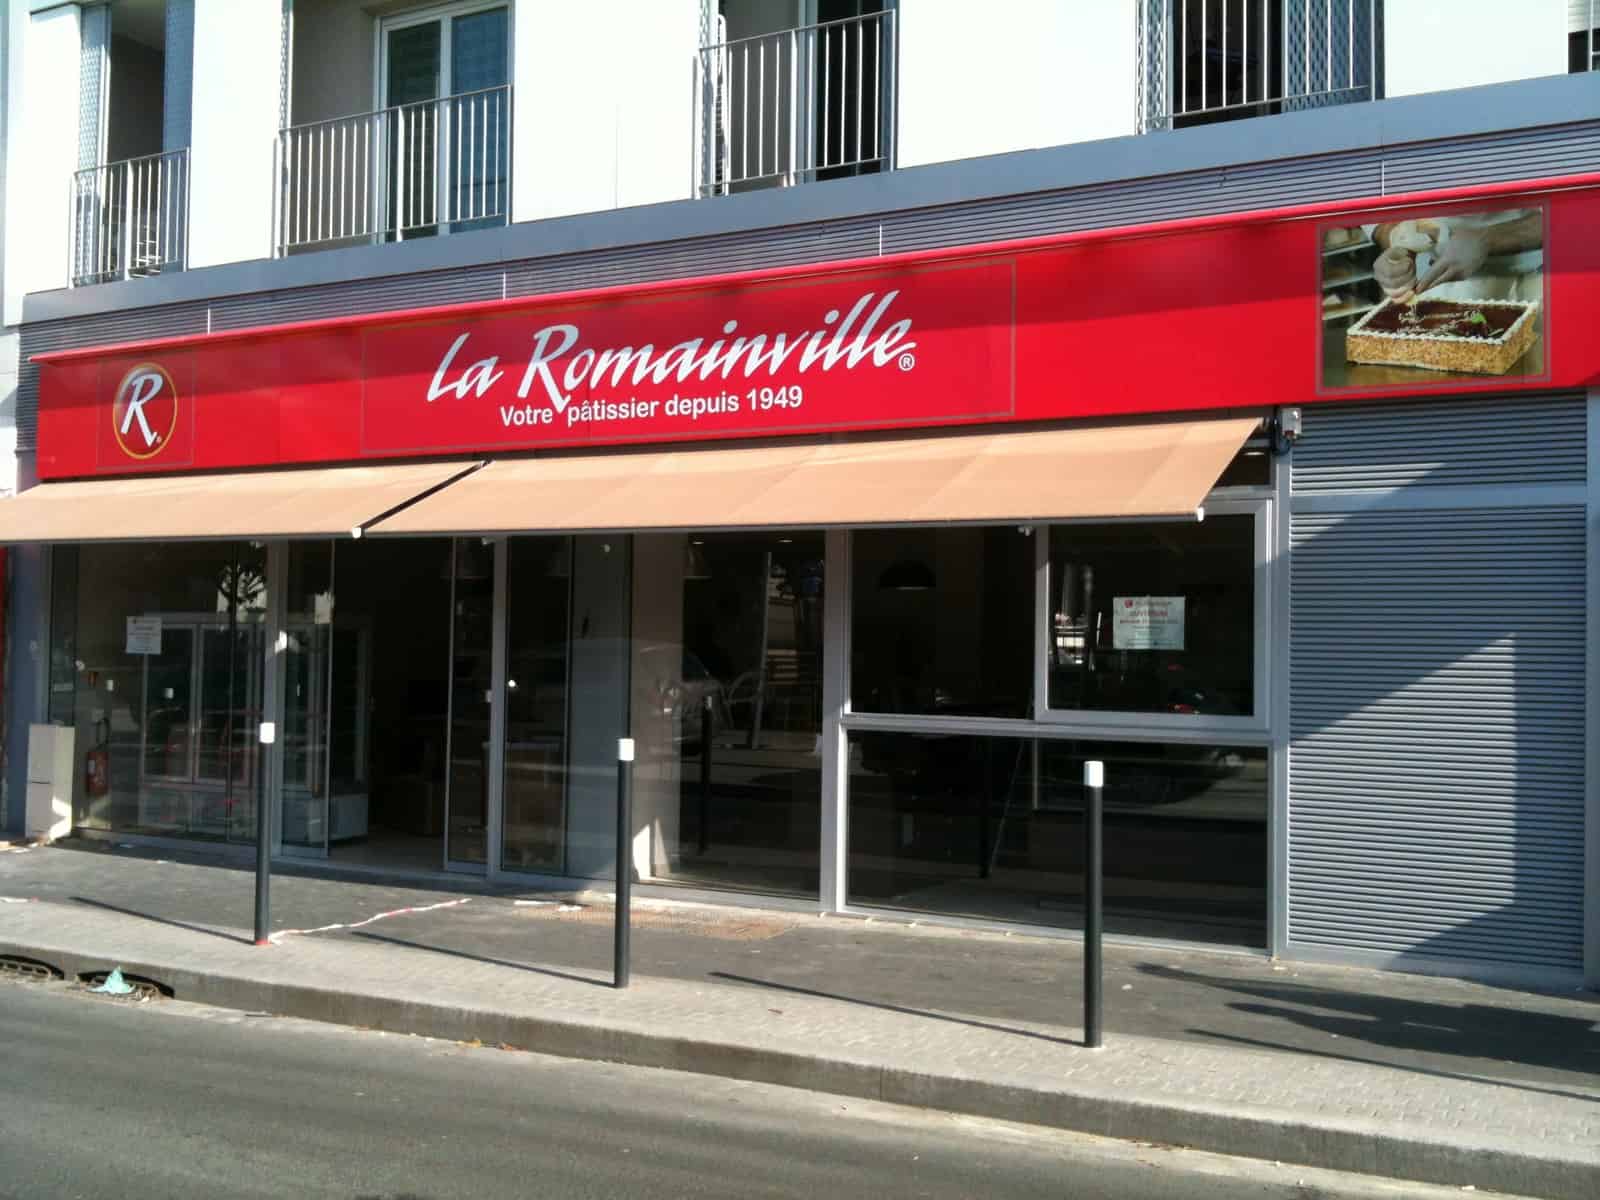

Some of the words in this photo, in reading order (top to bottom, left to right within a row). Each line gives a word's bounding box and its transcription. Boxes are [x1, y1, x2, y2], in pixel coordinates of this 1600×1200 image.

[427, 331, 504, 402] La
[517, 289, 918, 413] Romainville
[501, 404, 554, 427] Votre
[566, 394, 661, 428] pâtissier
[665, 389, 740, 418] depuis
[745, 385, 803, 411] 1949
